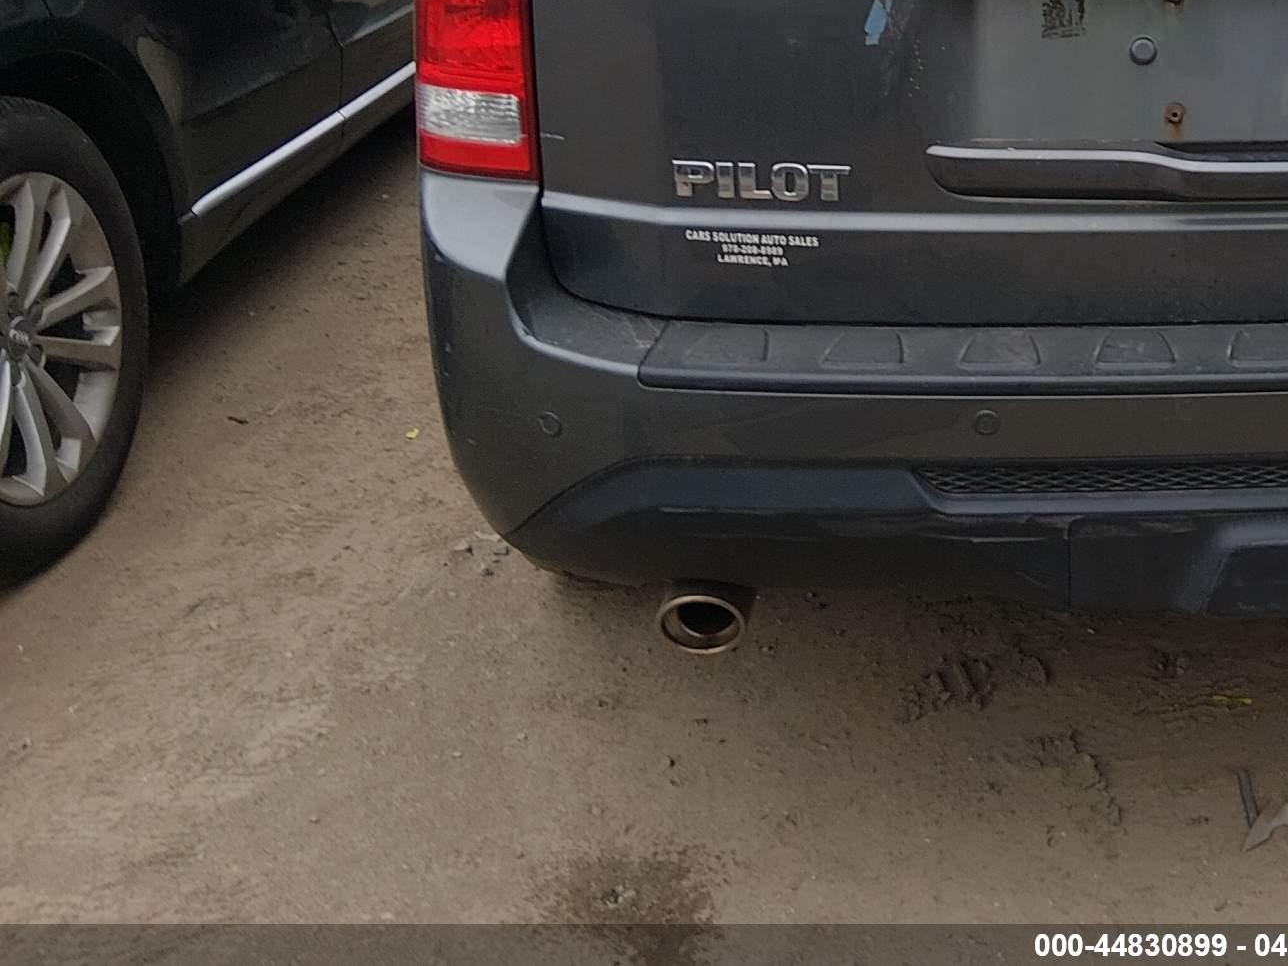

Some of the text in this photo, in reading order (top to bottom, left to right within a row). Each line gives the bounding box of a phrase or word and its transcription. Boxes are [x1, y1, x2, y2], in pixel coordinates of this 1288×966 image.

[672, 159, 851, 202] PILOT
[685, 229, 819, 248] CARS SOLUTION AUTO SALES
[717, 253, 789, 267] LAWRENCE, MA
